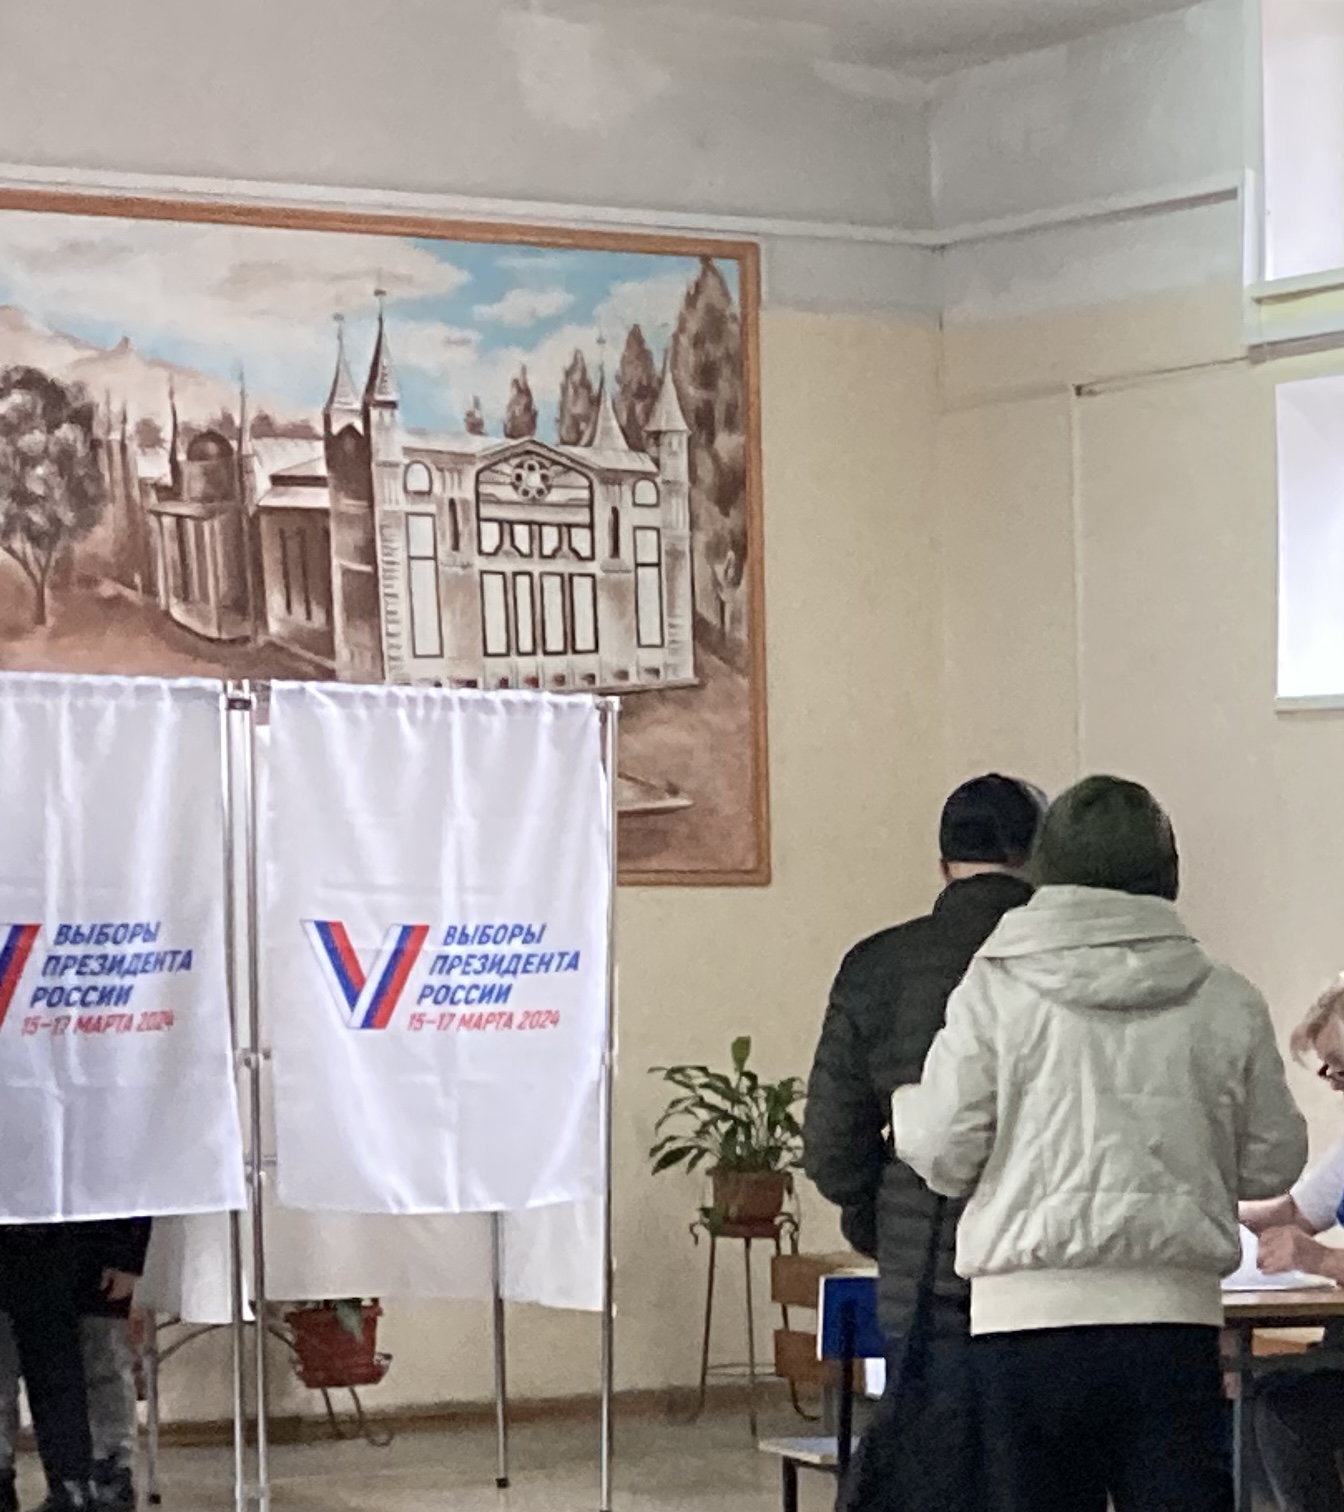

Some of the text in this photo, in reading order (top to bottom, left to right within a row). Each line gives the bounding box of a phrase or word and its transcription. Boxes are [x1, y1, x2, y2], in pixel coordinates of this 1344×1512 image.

[53, 921, 161, 946] ВЫБОРЫ
[442, 922, 547, 946] ВЫБОРЫ
[41, 949, 192, 978] ПРЕЗИДЕНТА
[428, 950, 581, 978] ПРЕЗИДЕНТА
[30, 984, 134, 1008] РОССИИ
[416, 983, 513, 1005] РОССИИ
[73, 1013, 134, 1035] МАРТА
[136, 1009, 174, 1032] 2024
[457, 1011, 514, 1031] МАРТА
[516, 1009, 561, 1030] 2024
